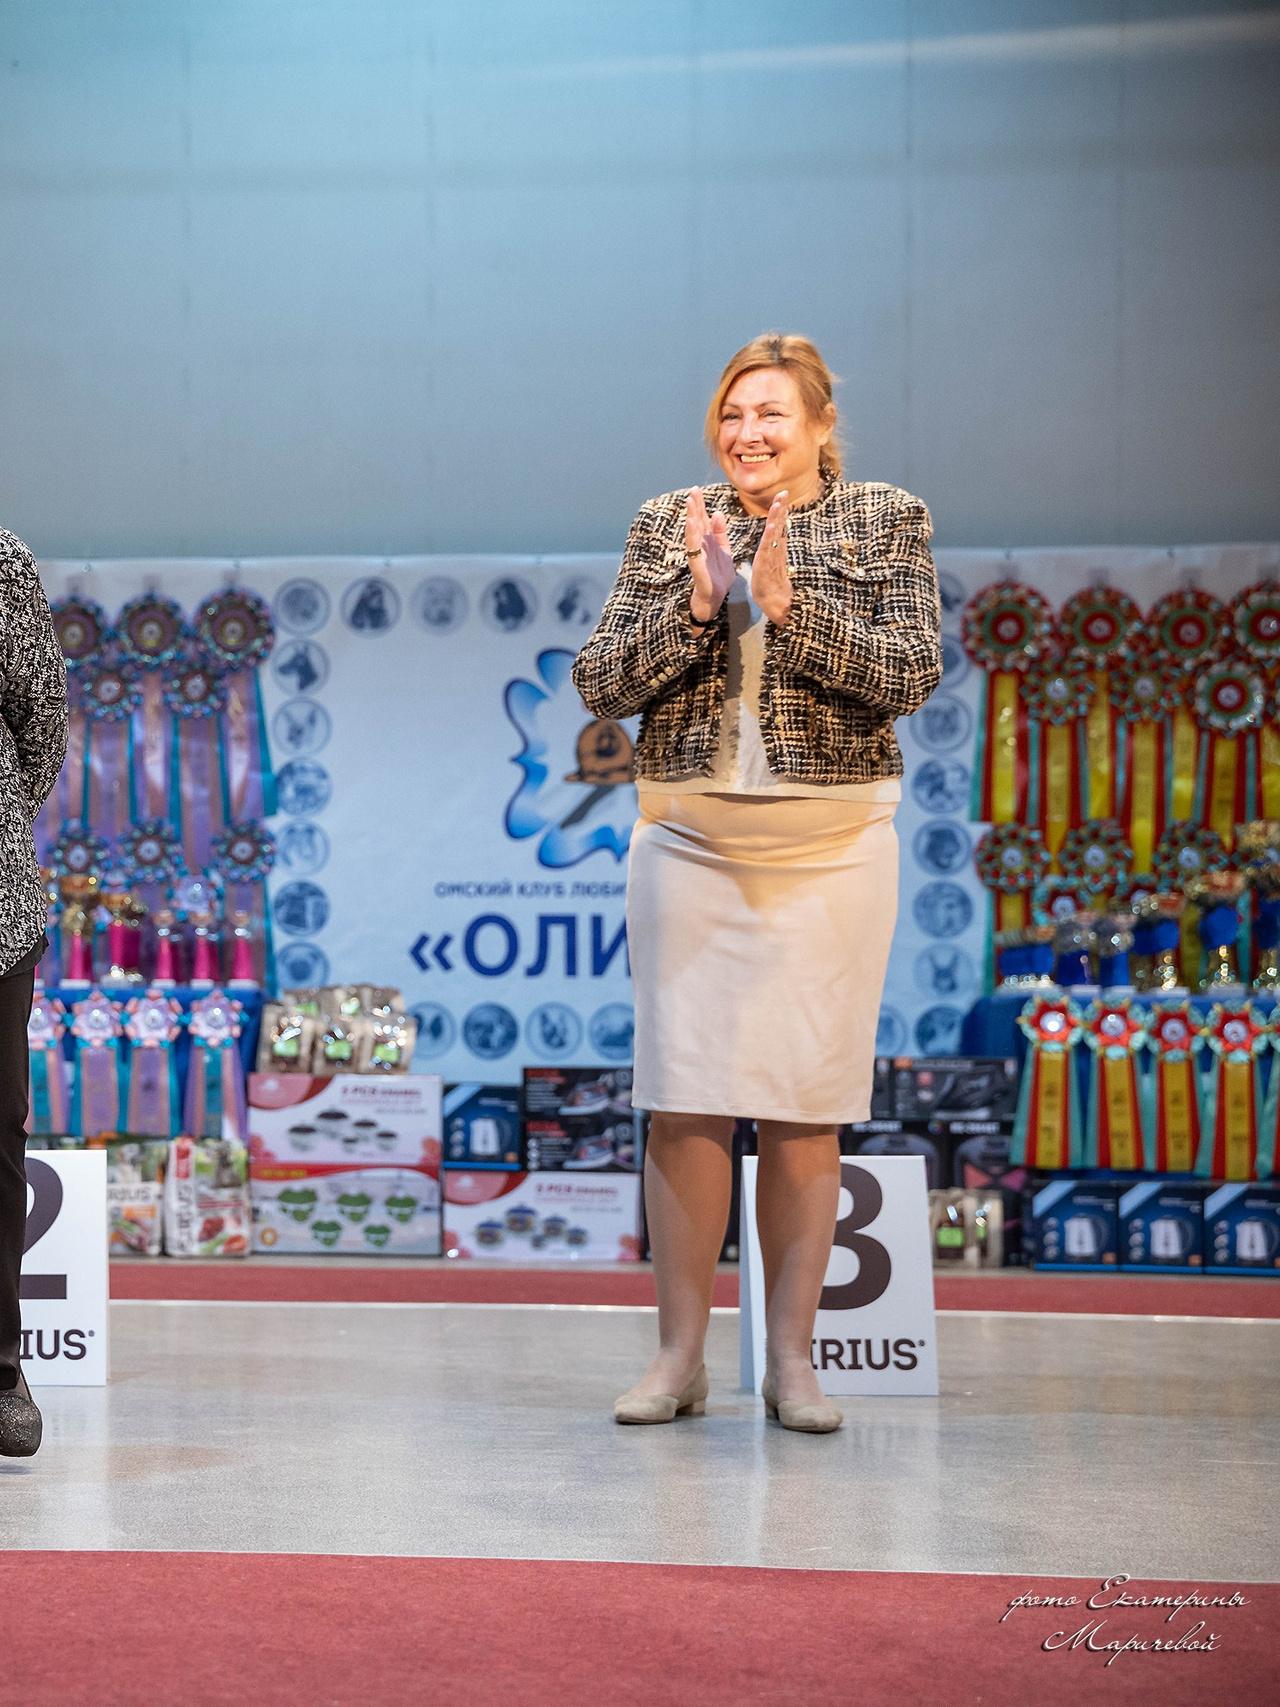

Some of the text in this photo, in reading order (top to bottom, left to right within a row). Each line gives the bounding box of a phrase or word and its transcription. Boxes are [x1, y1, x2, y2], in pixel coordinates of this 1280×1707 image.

[434, 878, 512, 898] ОМСКИЙ
[517, 881, 564, 898] КЛУБ
[19, 1157, 67, 1300] 2
[816, 1163, 892, 1310] 3
